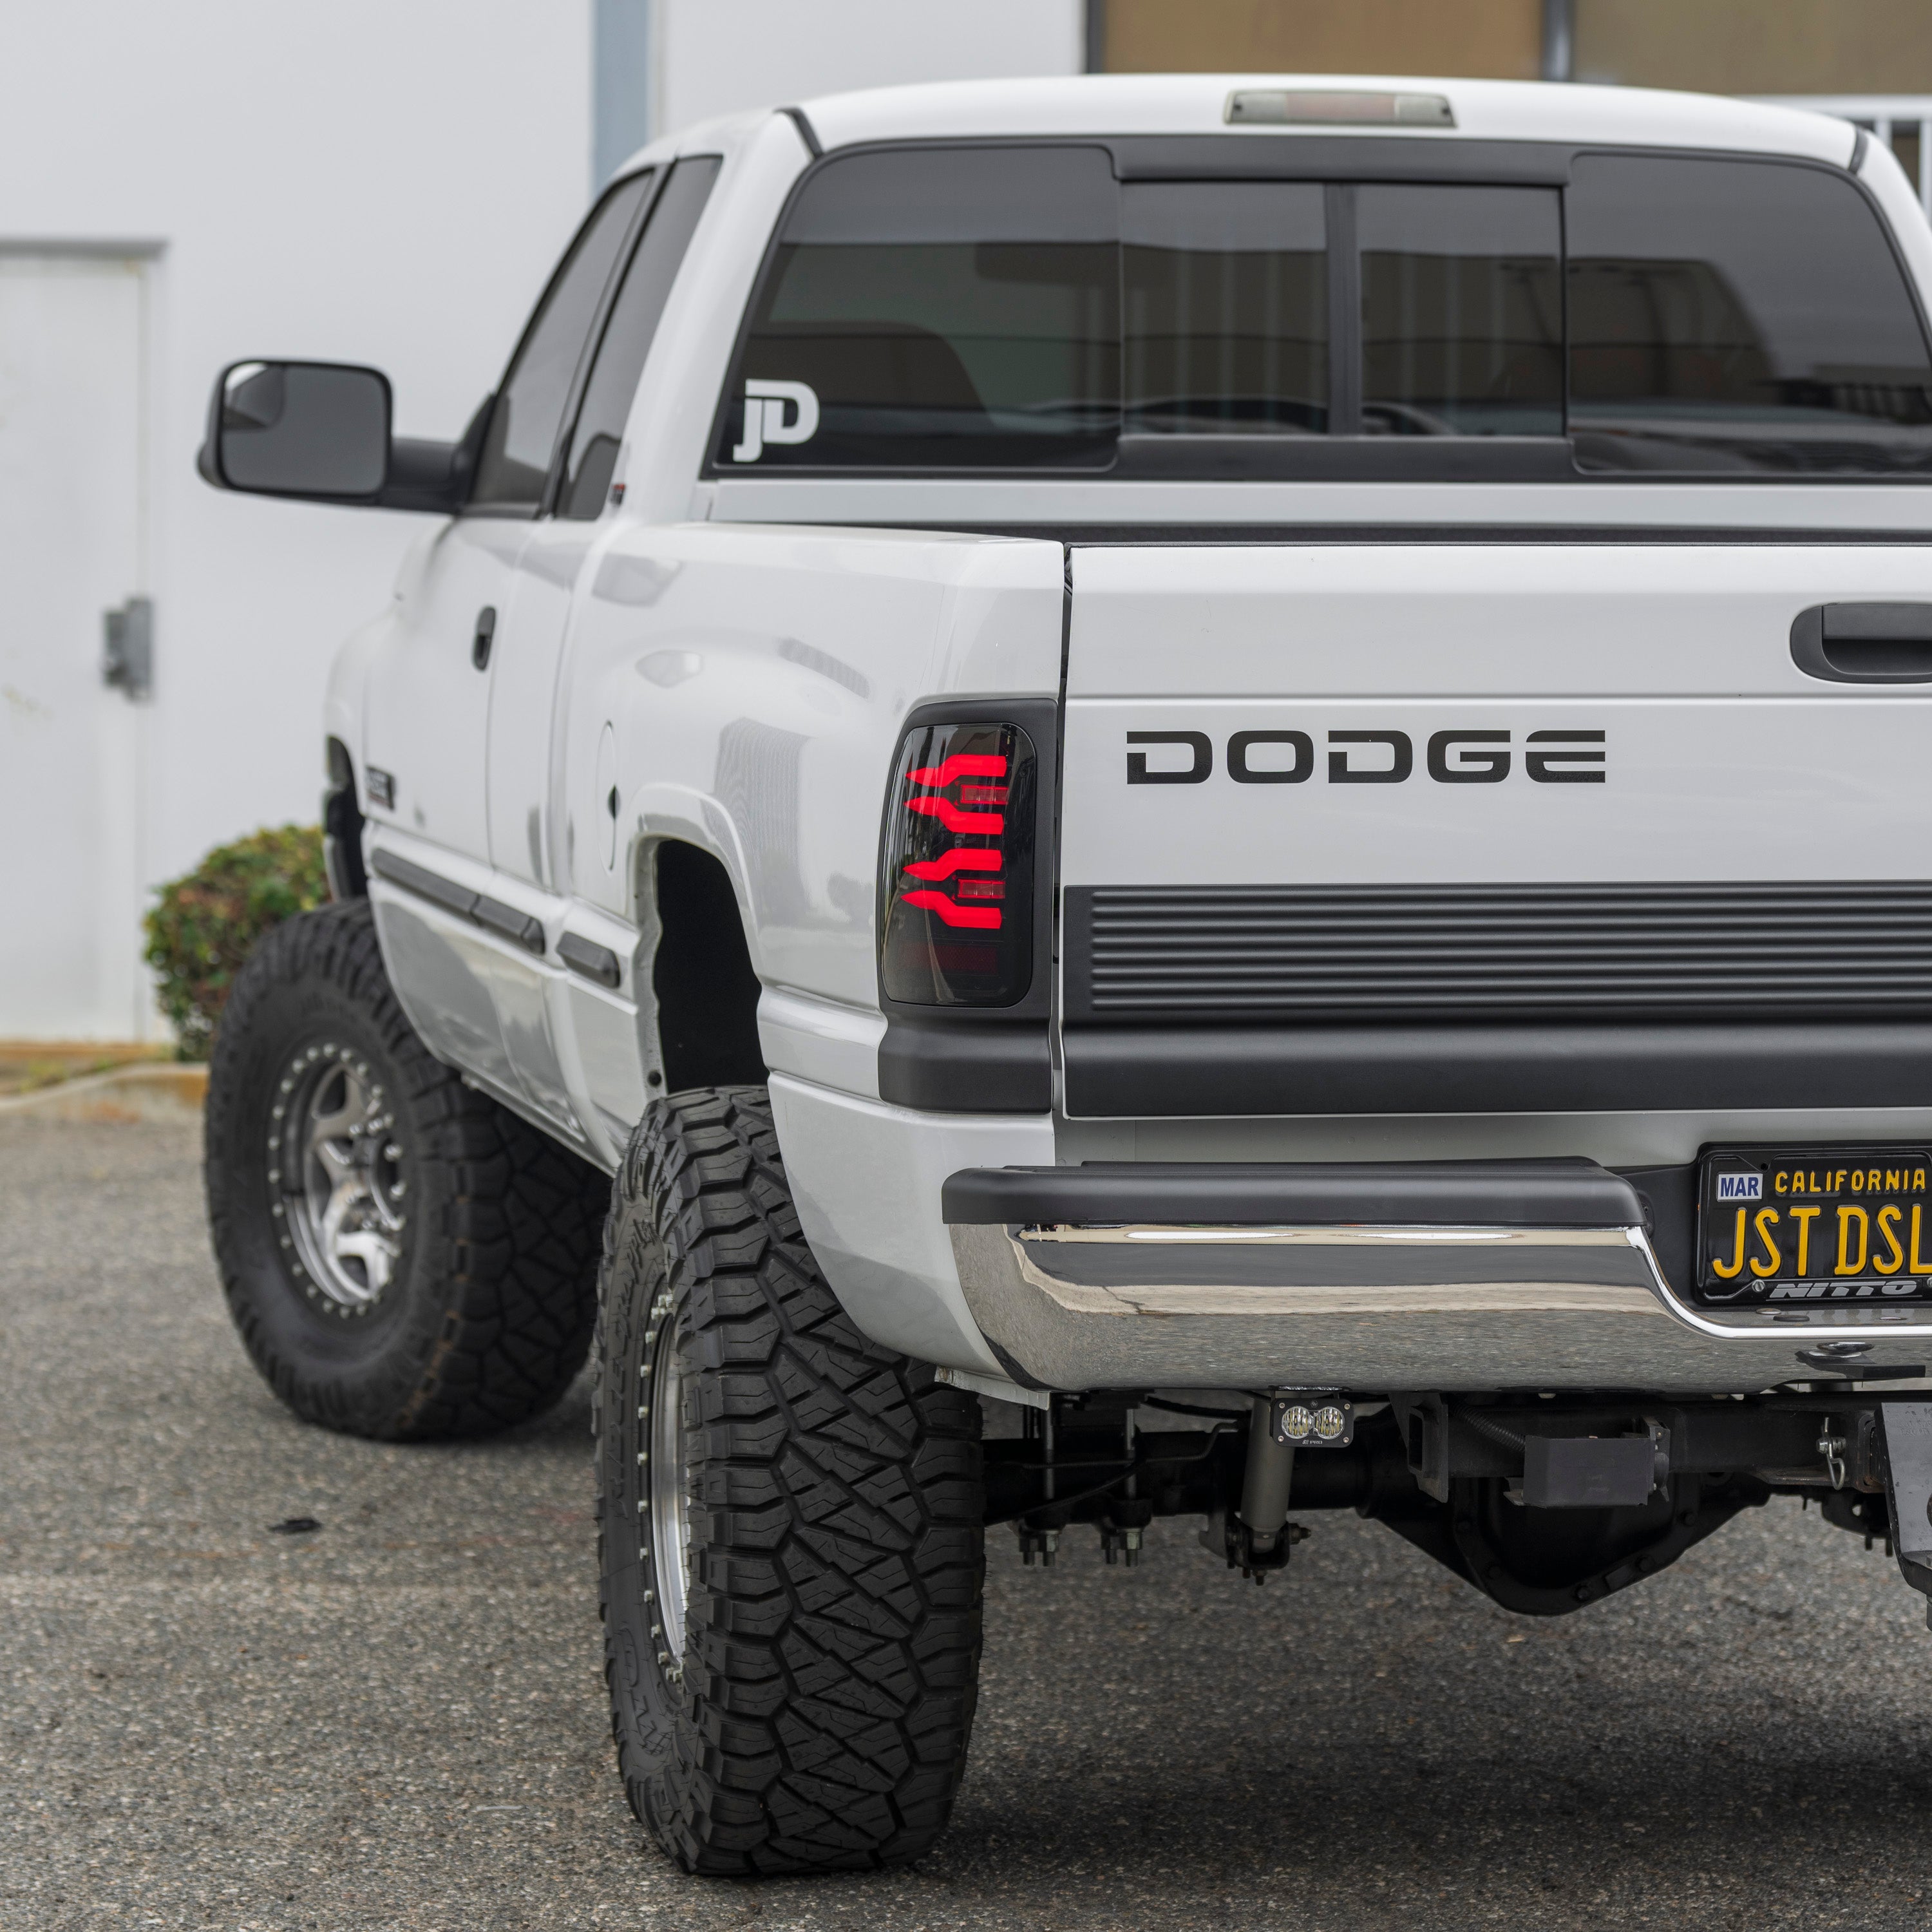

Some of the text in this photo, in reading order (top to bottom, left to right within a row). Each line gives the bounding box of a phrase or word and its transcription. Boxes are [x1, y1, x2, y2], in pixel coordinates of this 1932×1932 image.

[1127, 730, 1605, 784] DODGE
[1720, 1177, 1759, 1197] MAR
[1775, 1169, 1926, 1193] CALIFORNIA
[1712, 1205, 1932, 1279] JST DSL
[1769, 1280, 1917, 1298] NITTO
